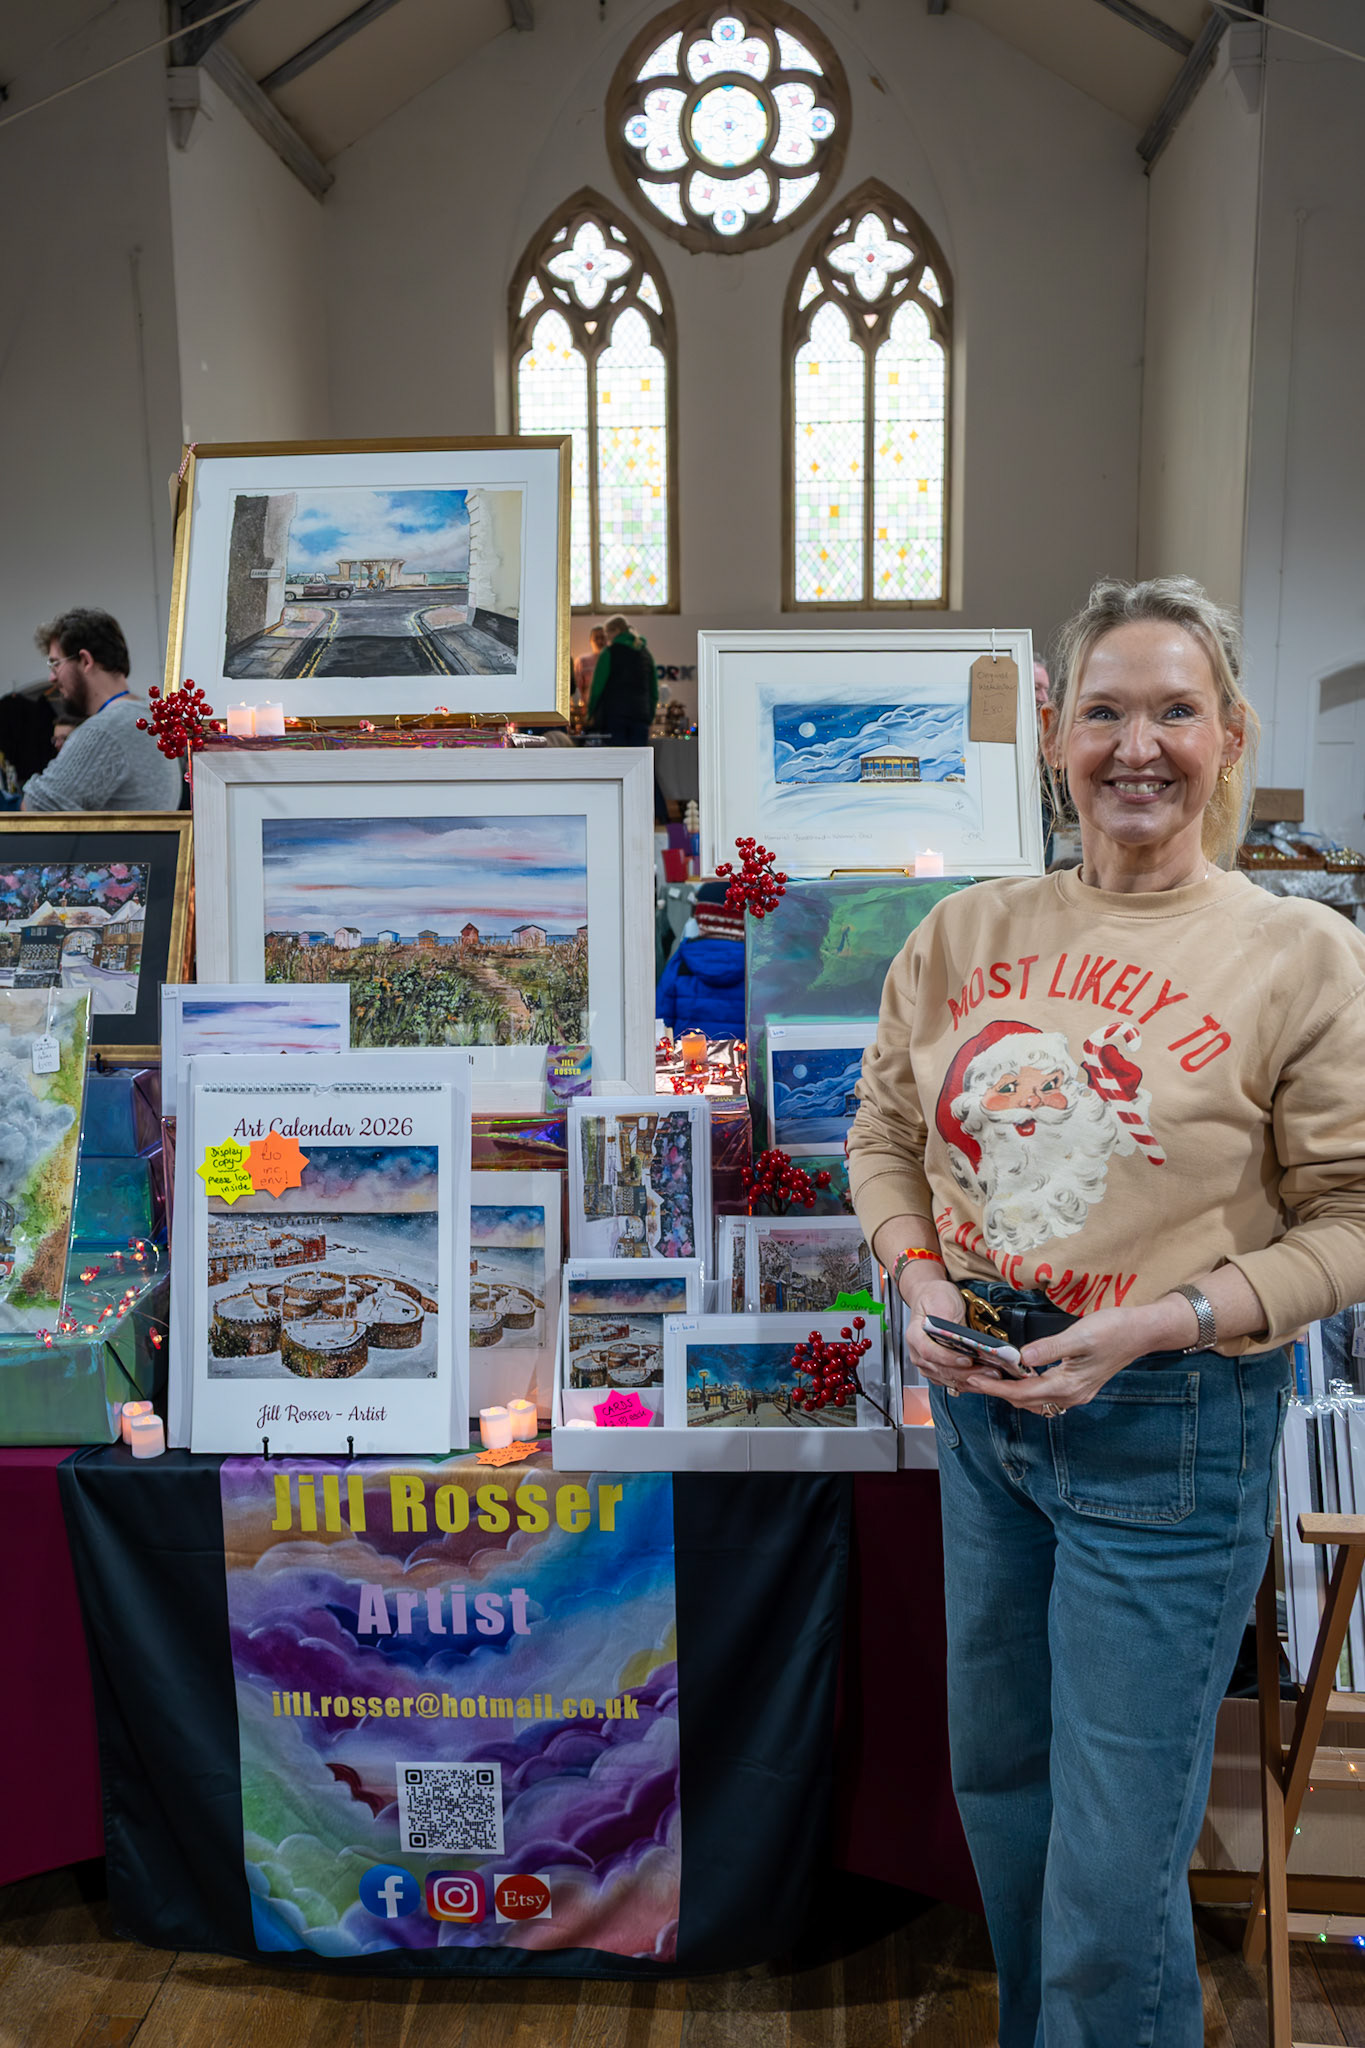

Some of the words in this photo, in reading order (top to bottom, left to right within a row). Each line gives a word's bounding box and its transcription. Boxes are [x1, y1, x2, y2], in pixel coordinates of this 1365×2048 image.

[947, 954, 1040, 1032] MOST
[1048, 953, 1189, 1025] LIKELY
[1167, 1014, 1232, 1073] TO
[554, 1068, 581, 1076] ROSSER
[561, 1059, 574, 1067] JILL
[233, 1117, 265, 1137] Art
[269, 1117, 355, 1137] Calendar
[359, 1117, 413, 1137] 2026
[211, 1147, 242, 1162] Display
[220, 1182, 251, 1193] inside
[255, 1404, 282, 1429] Jill
[285, 1404, 332, 1422] Rosser
[347, 1404, 388, 1422] Artist
[602, 1398, 634, 1416] CARDS
[271, 1474, 366, 1533] Jill
[390, 1475, 624, 1534] Rosser
[357, 1583, 532, 1636] Artist
[271, 1691, 640, 1722] jill.rosser@hotmail.co.uk
[501, 1889, 546, 1910] Etsy
